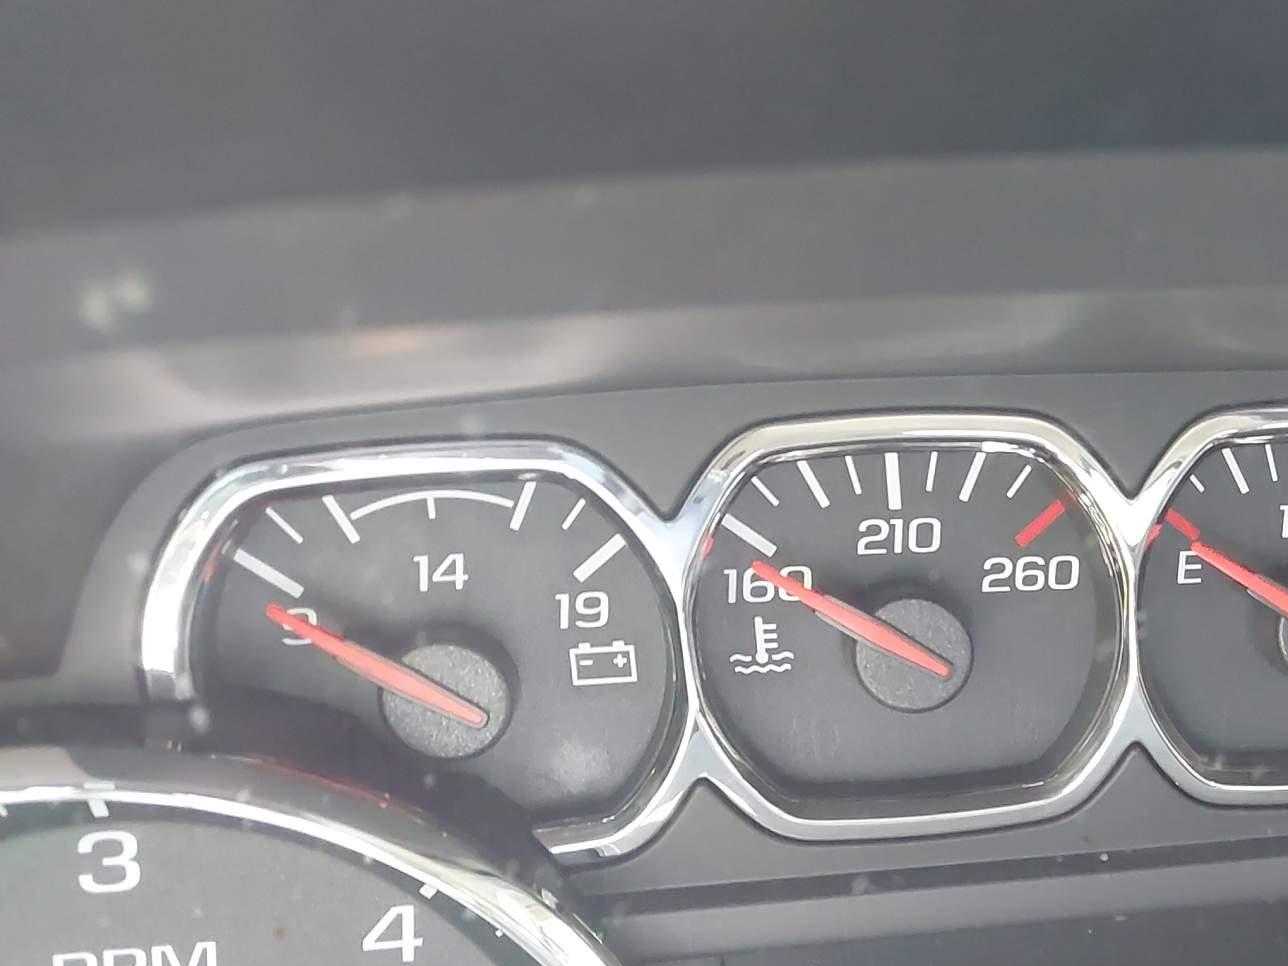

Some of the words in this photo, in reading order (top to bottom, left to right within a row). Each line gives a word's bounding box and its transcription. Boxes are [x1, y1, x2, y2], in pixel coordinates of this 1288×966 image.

[856, 517, 942, 555] 210
[413, 553, 469, 592] 14
[723, 565, 812, 604] 160
[981, 555, 1080, 593] 260
[1176, 550, 1202, 584] E
[555, 591, 611, 630] 19
[77, 831, 141, 894] 3
[362, 905, 424, 963] 4
